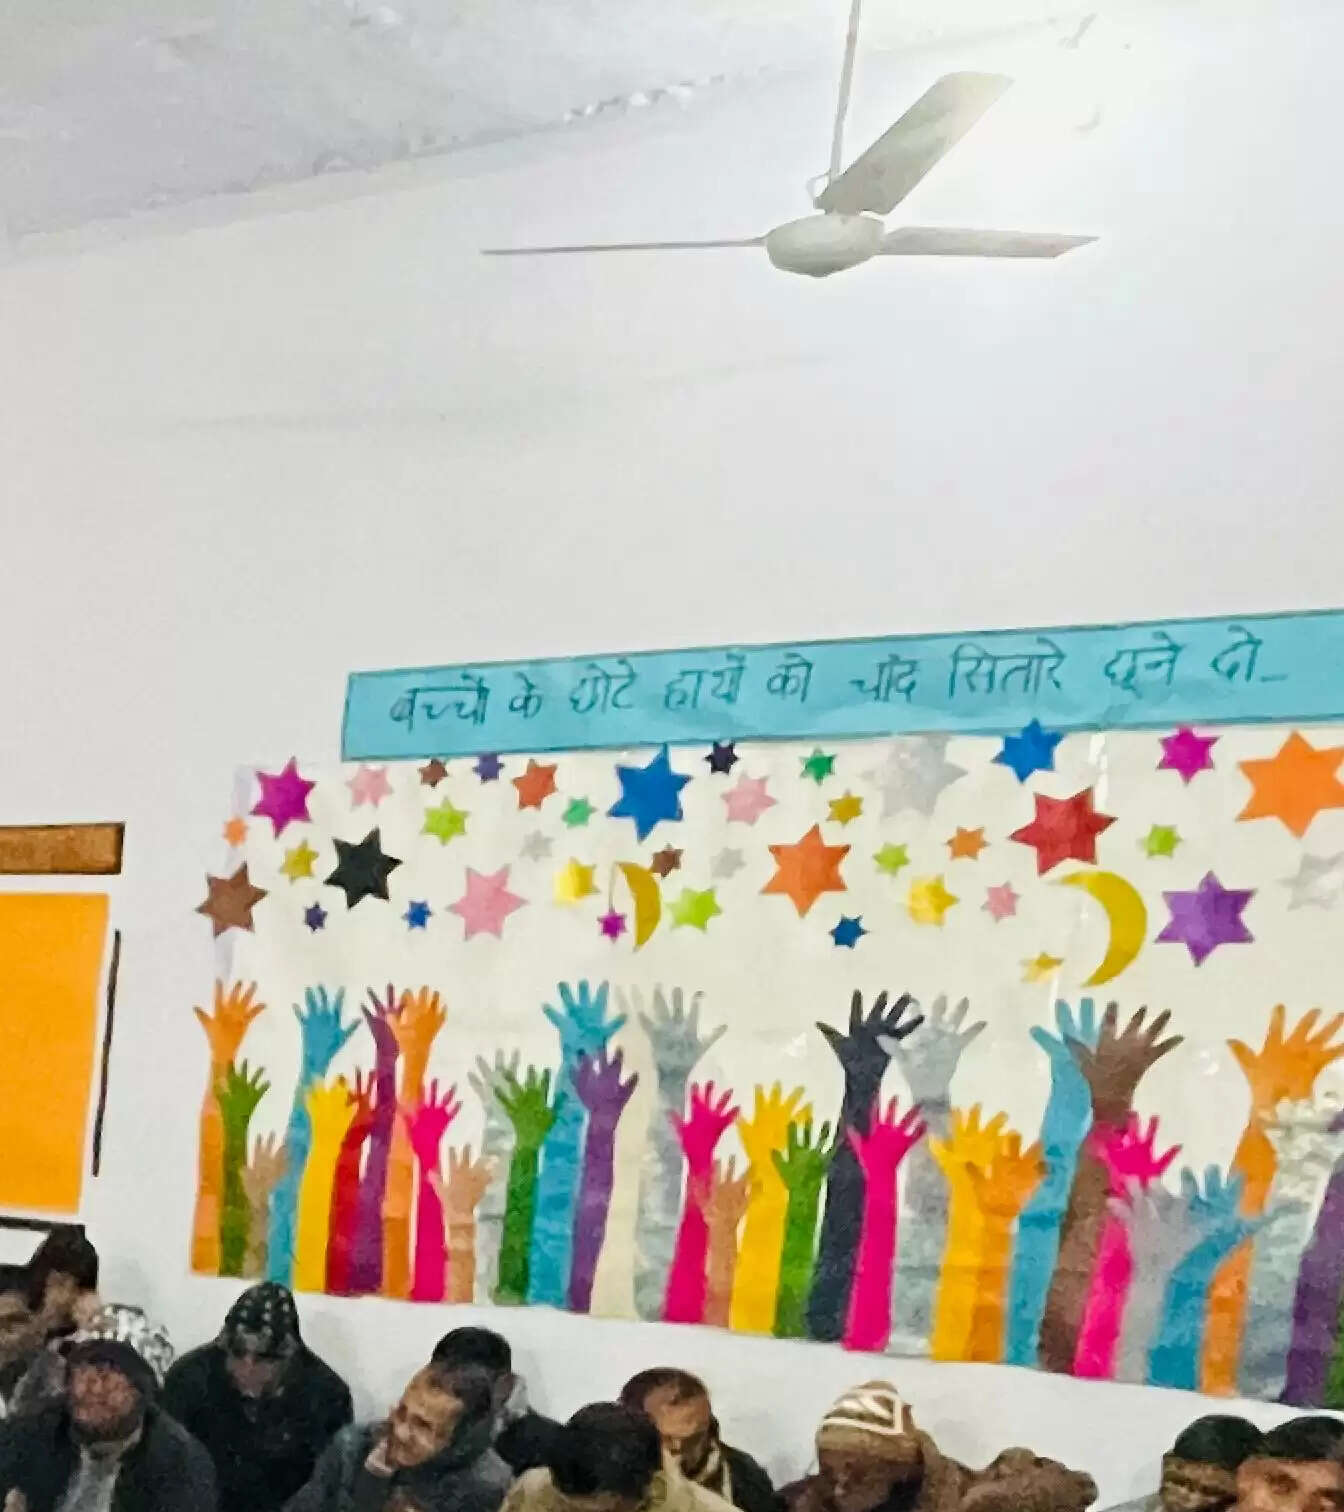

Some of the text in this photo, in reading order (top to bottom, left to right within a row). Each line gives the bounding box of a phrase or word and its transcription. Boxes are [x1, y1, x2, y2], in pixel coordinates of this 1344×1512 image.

[508, 671, 544, 718] के
[569, 657, 638, 714] छोटे
[766, 652, 814, 704] को
[949, 637, 1067, 699] सितारे
[1104, 631, 1185, 699] छूने
